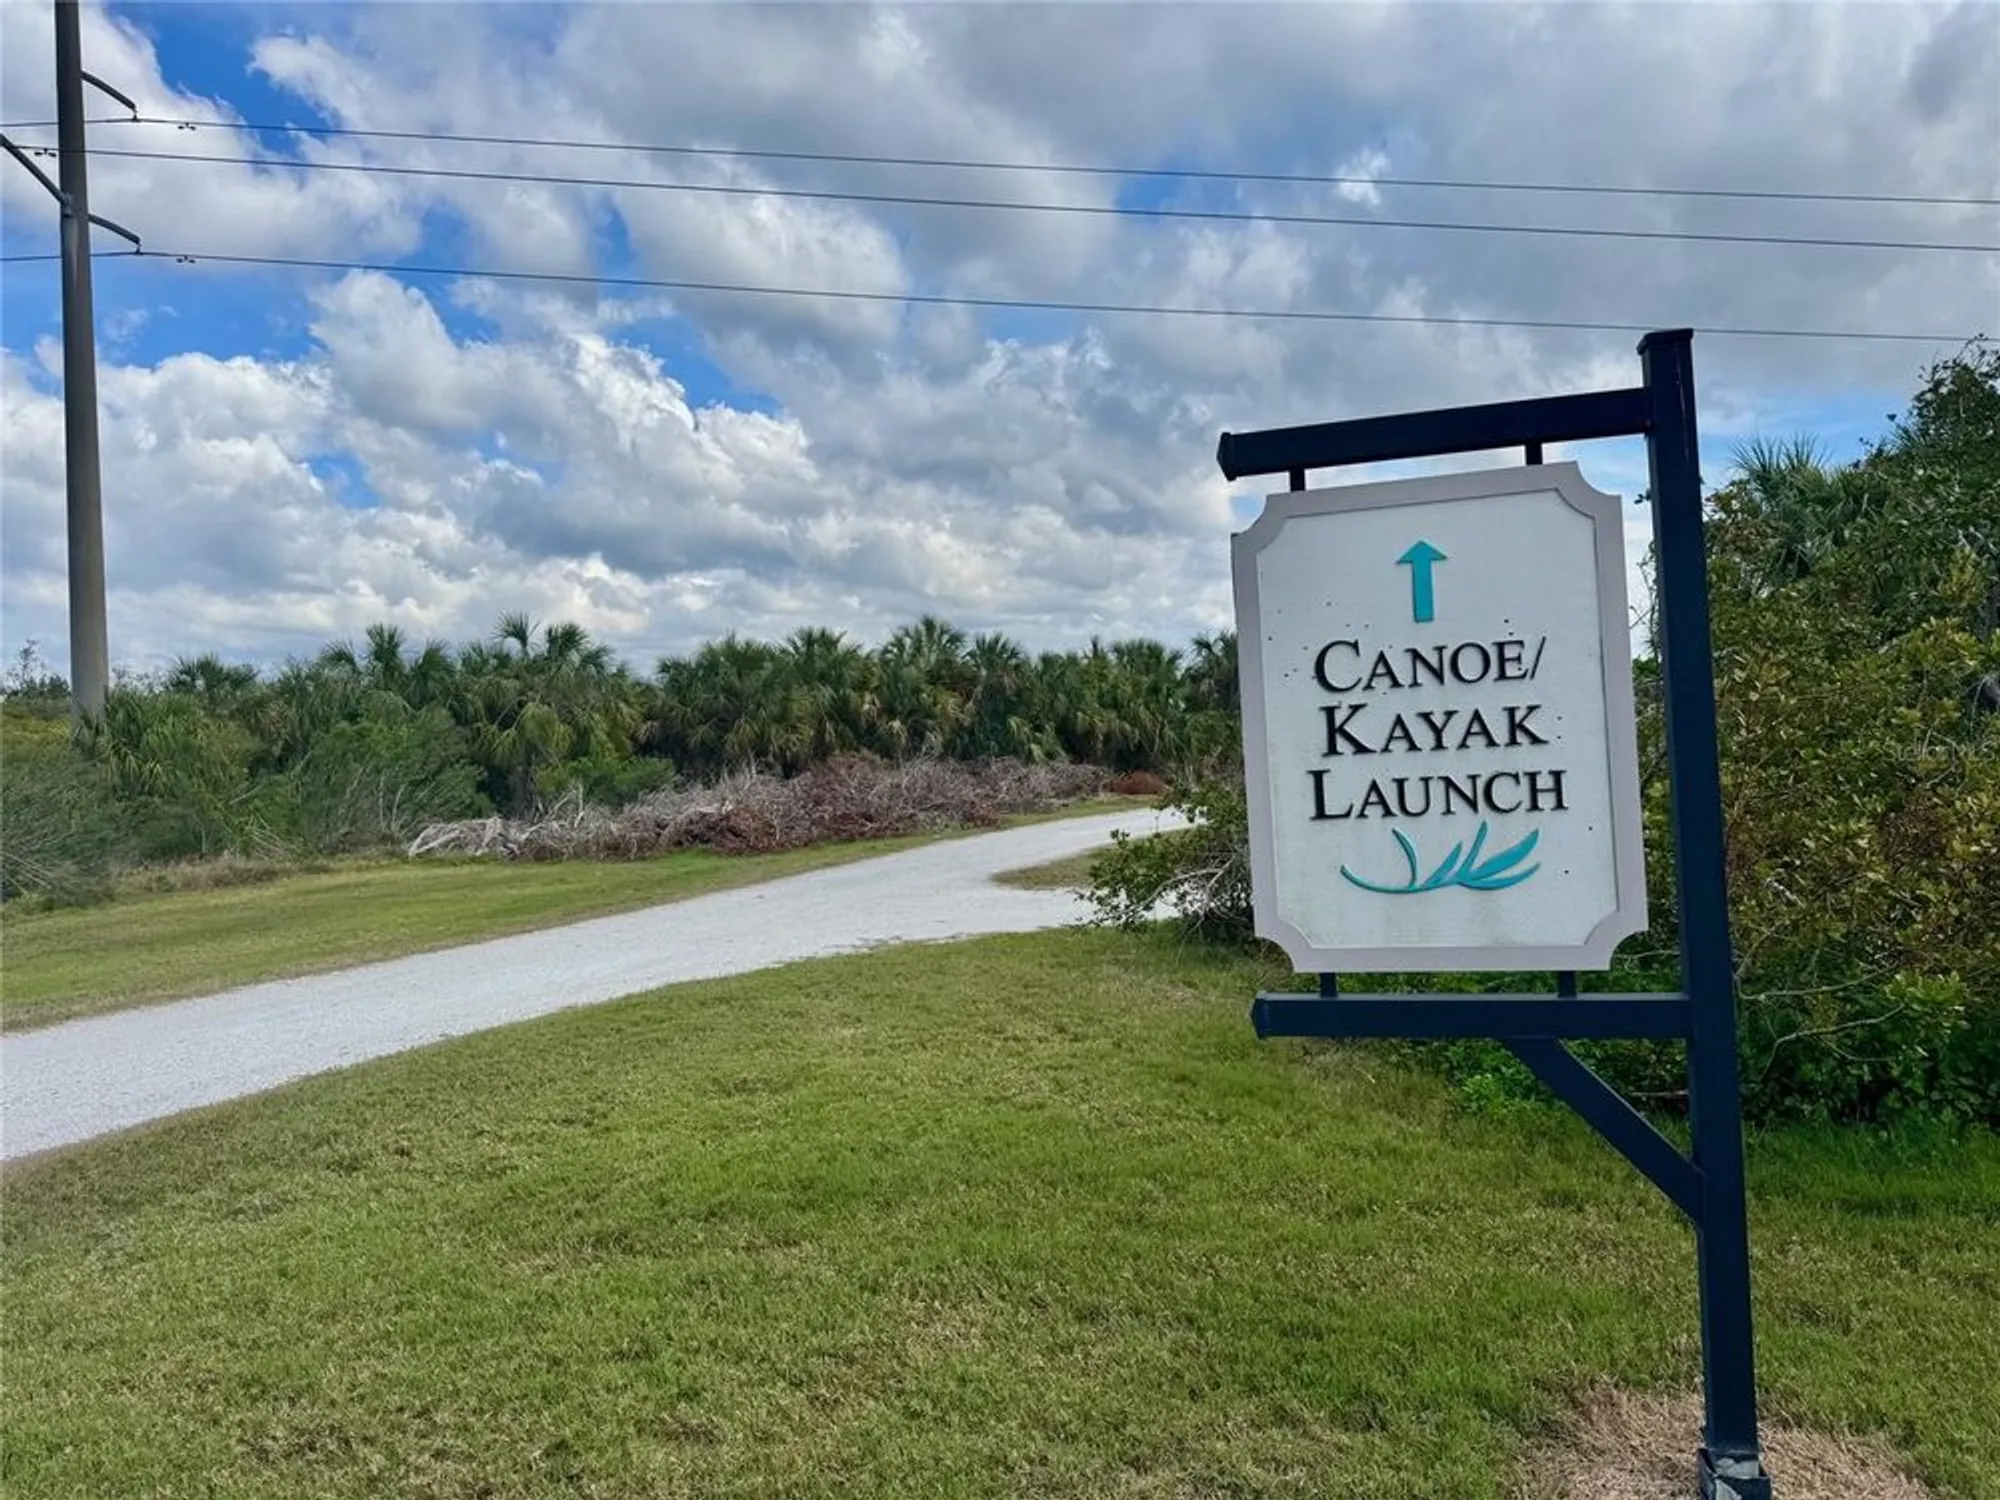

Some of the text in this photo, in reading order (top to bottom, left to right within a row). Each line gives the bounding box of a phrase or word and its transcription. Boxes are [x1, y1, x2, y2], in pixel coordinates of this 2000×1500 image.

[1314, 636, 1547, 694] CANOE/
[1319, 703, 1550, 758] KAYAK
[1307, 769, 1569, 821] LAUNCH
